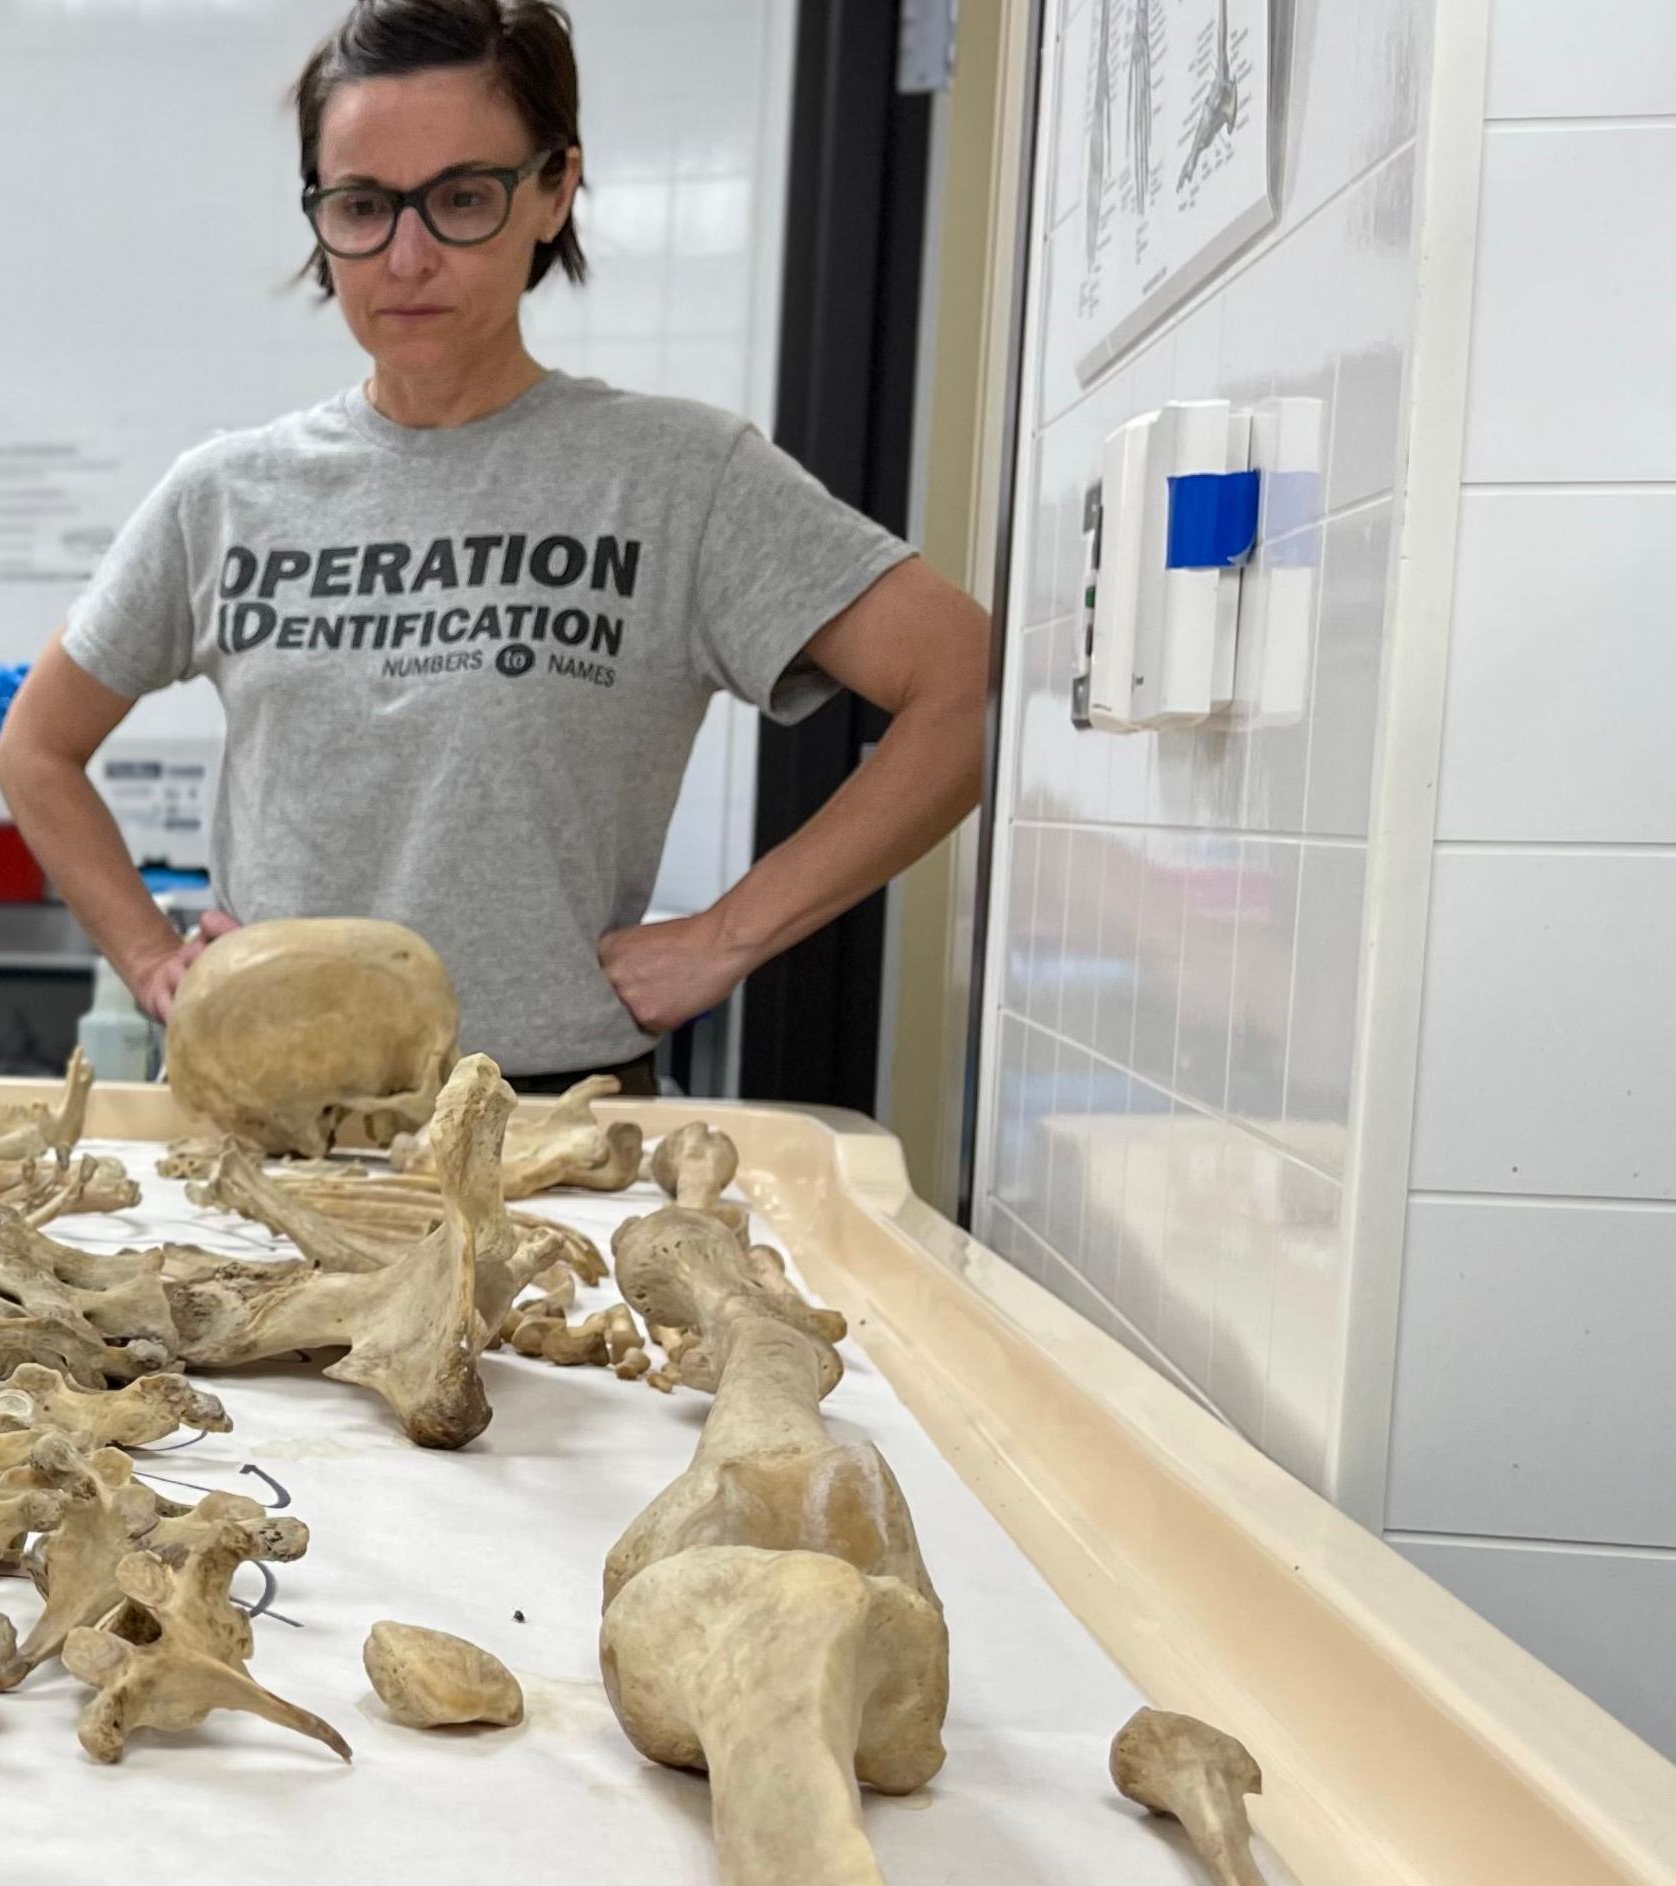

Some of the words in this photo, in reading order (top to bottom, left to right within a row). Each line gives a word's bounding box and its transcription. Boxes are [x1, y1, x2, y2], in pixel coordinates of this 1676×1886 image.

[221, 534, 641, 599] OPERATION
[218, 602, 624, 657] IDENTIFICATION
[381, 650, 485, 678] NUMBERS
[547, 653, 617, 689] NAMES
